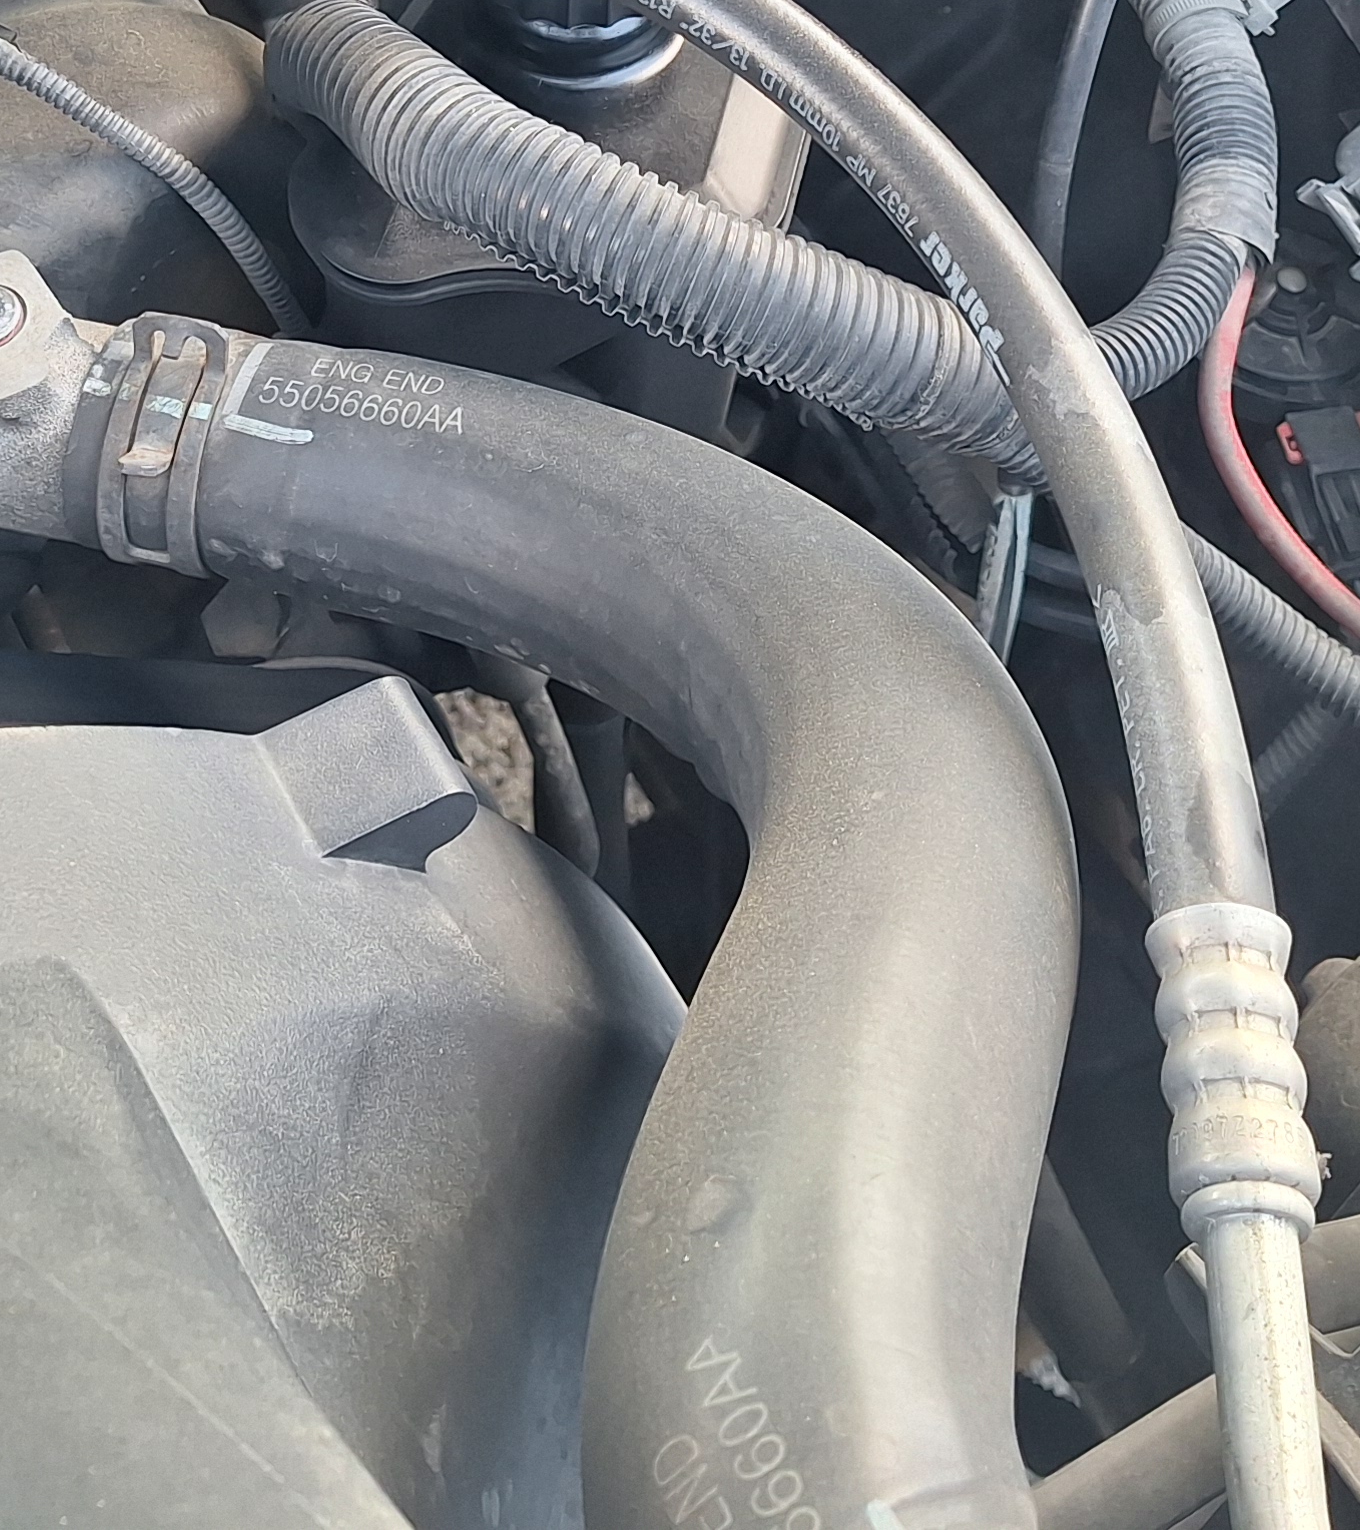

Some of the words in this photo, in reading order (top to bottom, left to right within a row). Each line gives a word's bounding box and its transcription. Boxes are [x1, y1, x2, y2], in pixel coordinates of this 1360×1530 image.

[845, 153, 877, 188] MP
[876, 183, 921, 238] 7637
[919, 231, 1008, 372] Parker
[309, 355, 376, 383] ENG
[381, 366, 447, 398] END
[256, 374, 467, 437] 55056660AA
